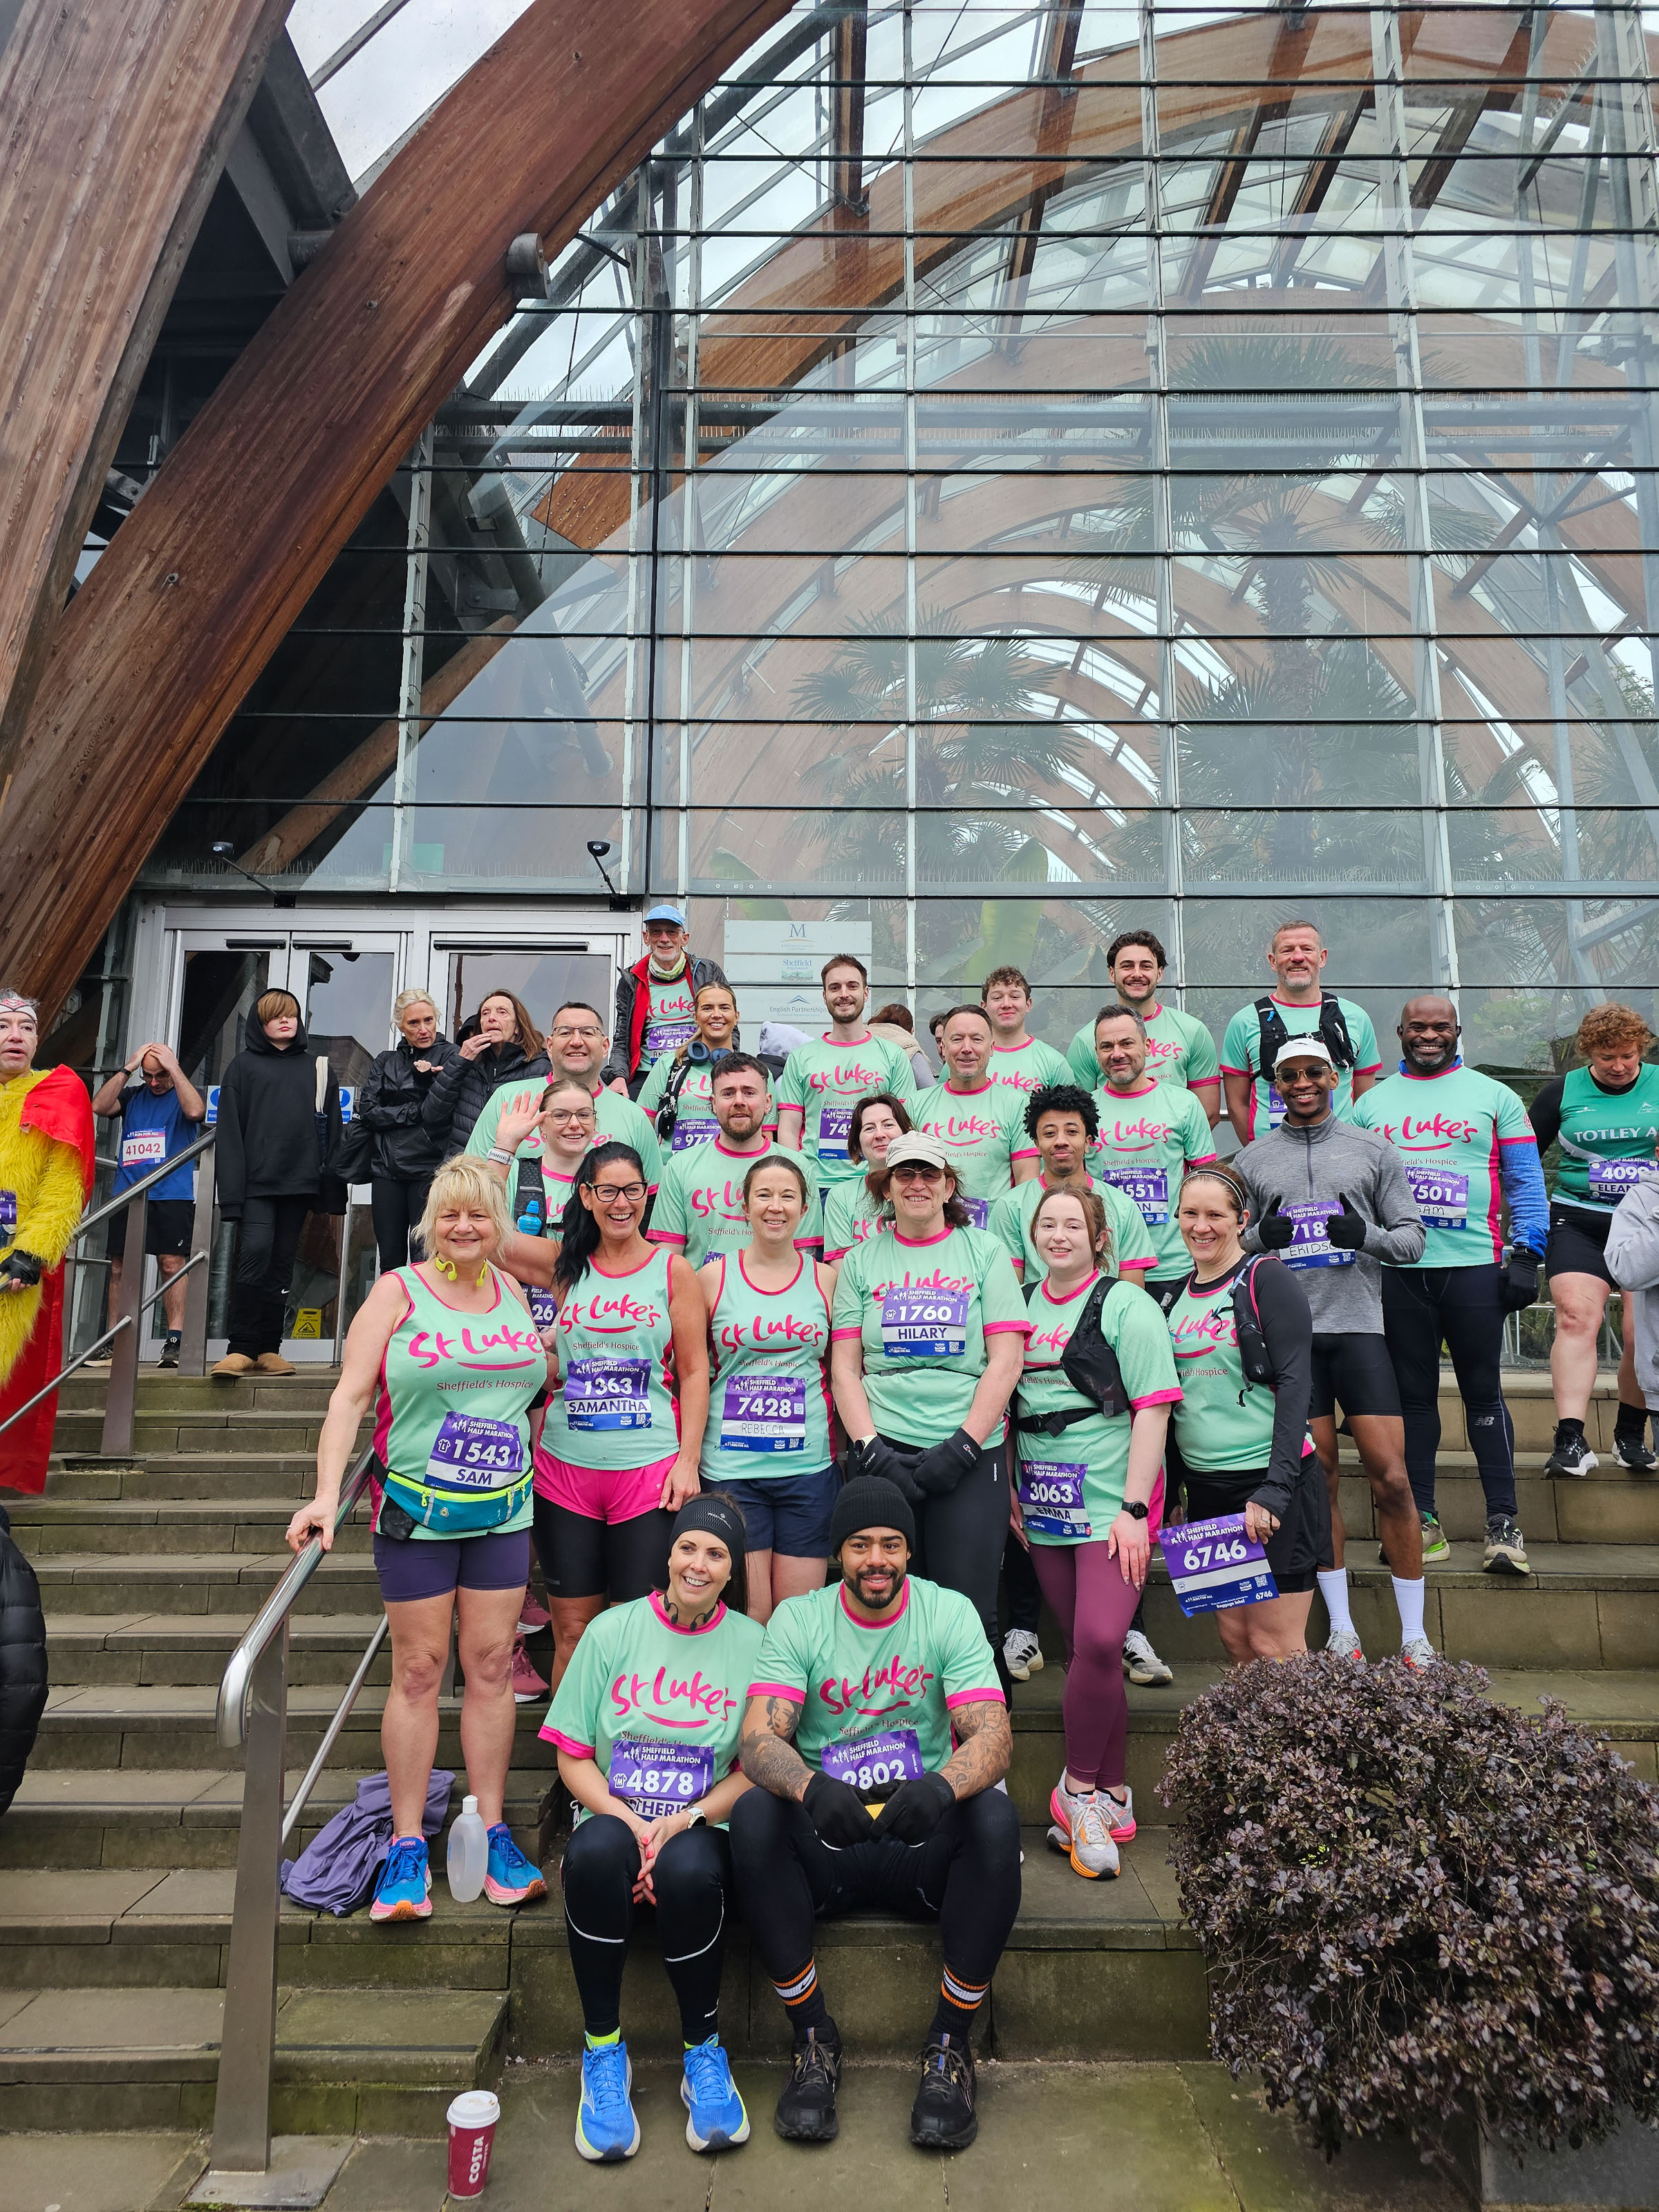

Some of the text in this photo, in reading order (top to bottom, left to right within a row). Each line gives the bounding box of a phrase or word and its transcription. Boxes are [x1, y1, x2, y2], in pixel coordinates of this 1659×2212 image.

[789, 924, 806, 937] M
[660, 996, 695, 1014] Luke
[1151, 1039, 1183, 1060] ke's
[810, 1063, 883, 1094] St Luke's
[830, 1123, 851, 1136] 74
[948, 1115, 1001, 1138] Luke's
[1115, 1118, 1172, 1143] Luke's
[1374, 1113, 1478, 1144] t Luke's
[1574, 1127, 1641, 1143] TOTLEY
[126, 1143, 160, 1155] 41042
[1425, 1158, 1457, 1166] Hospice
[1428, 1176, 1460, 1185] MARATHON
[1598, 1184, 1634, 1193] ELEAN
[692, 1188, 720, 1218] St
[1136, 1203, 1152, 1212] N
[1307, 1209, 1339, 1218] MARATHON
[709, 1228, 740, 1236] Seffield's
[1292, 1221, 1328, 1240] 18
[1289, 1243, 1336, 1257] ERIDS
[532, 1304, 554, 1321] 26
[559, 1294, 661, 1334] St Luke's
[899, 1305, 952, 1322] 1760
[721, 1314, 823, 1354] St Luke's
[898, 1327, 947, 1340] HILARY
[409, 1324, 543, 1369] St Luke
[573, 1342, 639, 1351] Sheffield's Hospice
[1196, 1367, 1228, 1378] Hospice
[437, 1379, 534, 1392] Sheffield's Hospice
[584, 1378, 632, 1396] 1363
[569, 1400, 648, 1413] SAMANTHA
[736, 1397, 792, 1418] 7428
[467, 1427, 514, 1439] HALF MARATHON
[469, 1421, 498, 1430] SHEFFIELD
[741, 1423, 785, 1435] REBECCA
[452, 1438, 511, 1467] 1543
[456, 1469, 492, 1485] SAM
[1030, 1482, 1074, 1503] 3063
[1035, 1507, 1071, 1521] EMMA
[1186, 1524, 1217, 1535] SHEFFIELD
[1188, 1525, 1244, 1541] HALF MARATHON
[1183, 1539, 1247, 1571] 6746
[1255, 1591, 1273, 1600] 6746
[611, 1666, 737, 1721] St Luke's
[819, 1655, 934, 1716] St Luke's
[882, 1718, 919, 1728] Hospice
[849, 1740, 879, 1754] SHEFFIELD
[850, 1742, 906, 1761] HALF MARATHON
[659, 1754, 701, 1764] MARATHON
[842, 1759, 906, 1790] 2802
[626, 1770, 693, 1796] 4878
[469, 2135, 484, 2184] COSTA
